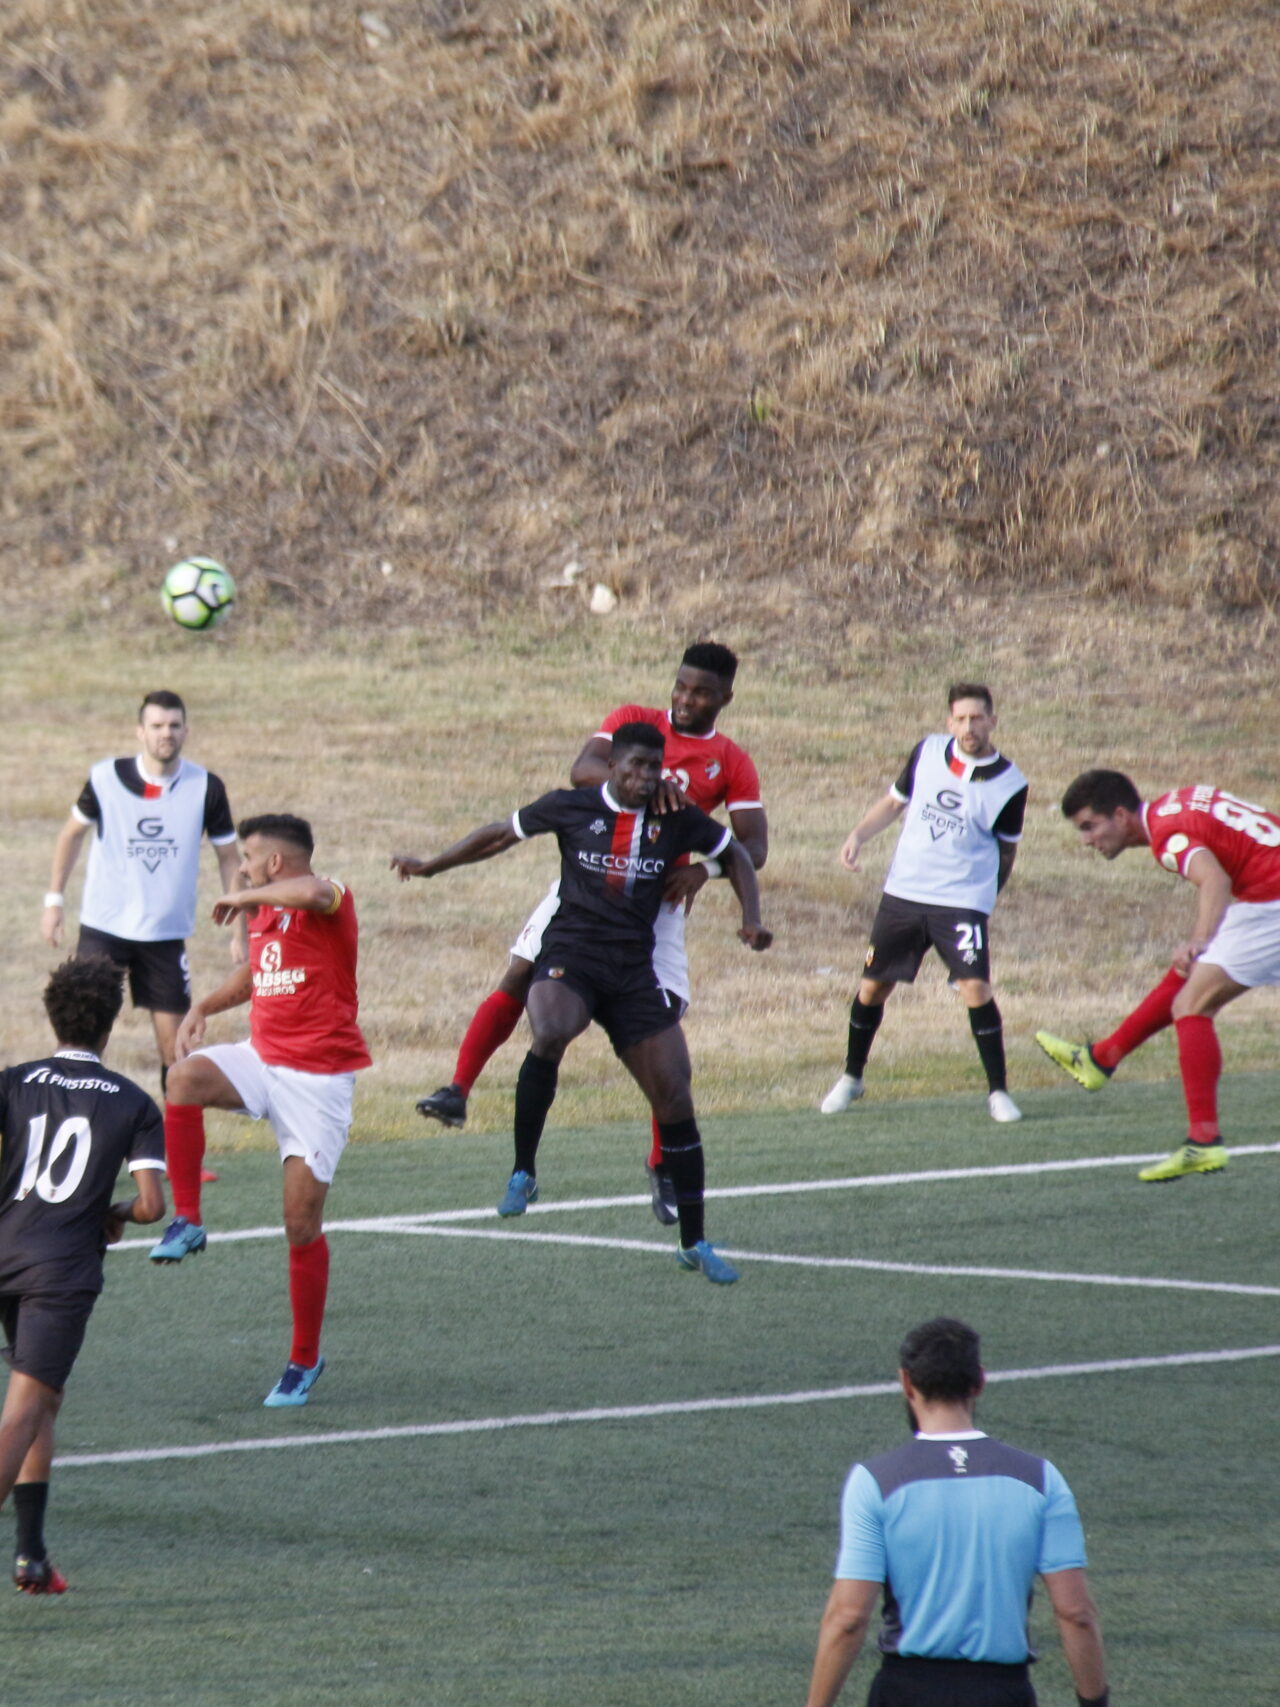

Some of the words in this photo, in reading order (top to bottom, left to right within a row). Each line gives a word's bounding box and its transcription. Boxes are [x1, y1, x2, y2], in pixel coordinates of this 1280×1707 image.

[936, 789, 963, 812] G
[136, 817, 164, 838] G
[921, 809, 967, 837] SPORT
[1211, 789, 1280, 848] 8
[126, 846, 179, 858] SPORT
[955, 922, 983, 951] 21
[49, 1073, 120, 1094] FIRSTSTOP
[14, 1113, 92, 1204] 10
